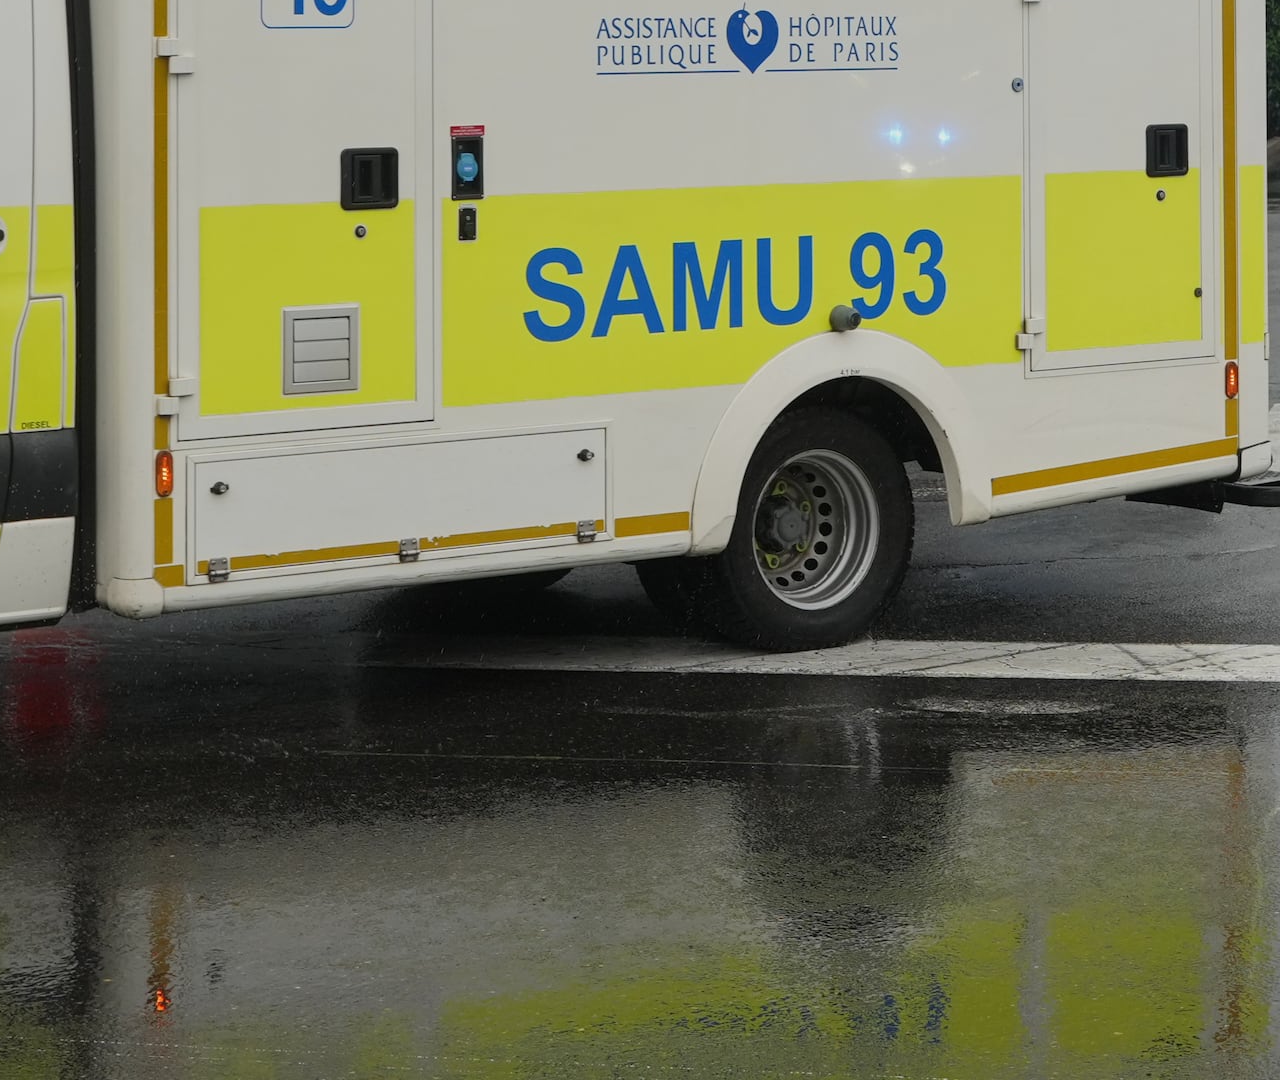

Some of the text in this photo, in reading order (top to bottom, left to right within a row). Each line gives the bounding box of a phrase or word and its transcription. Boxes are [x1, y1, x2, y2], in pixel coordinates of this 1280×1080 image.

[597, 13, 897, 39] ASSISTANCE HÔPITAUX
[597, 41, 899, 69] PUBLIQUE DE PARIS
[522, 228, 947, 342] SAMU 93
[21, 420, 52, 430] DIESEL
